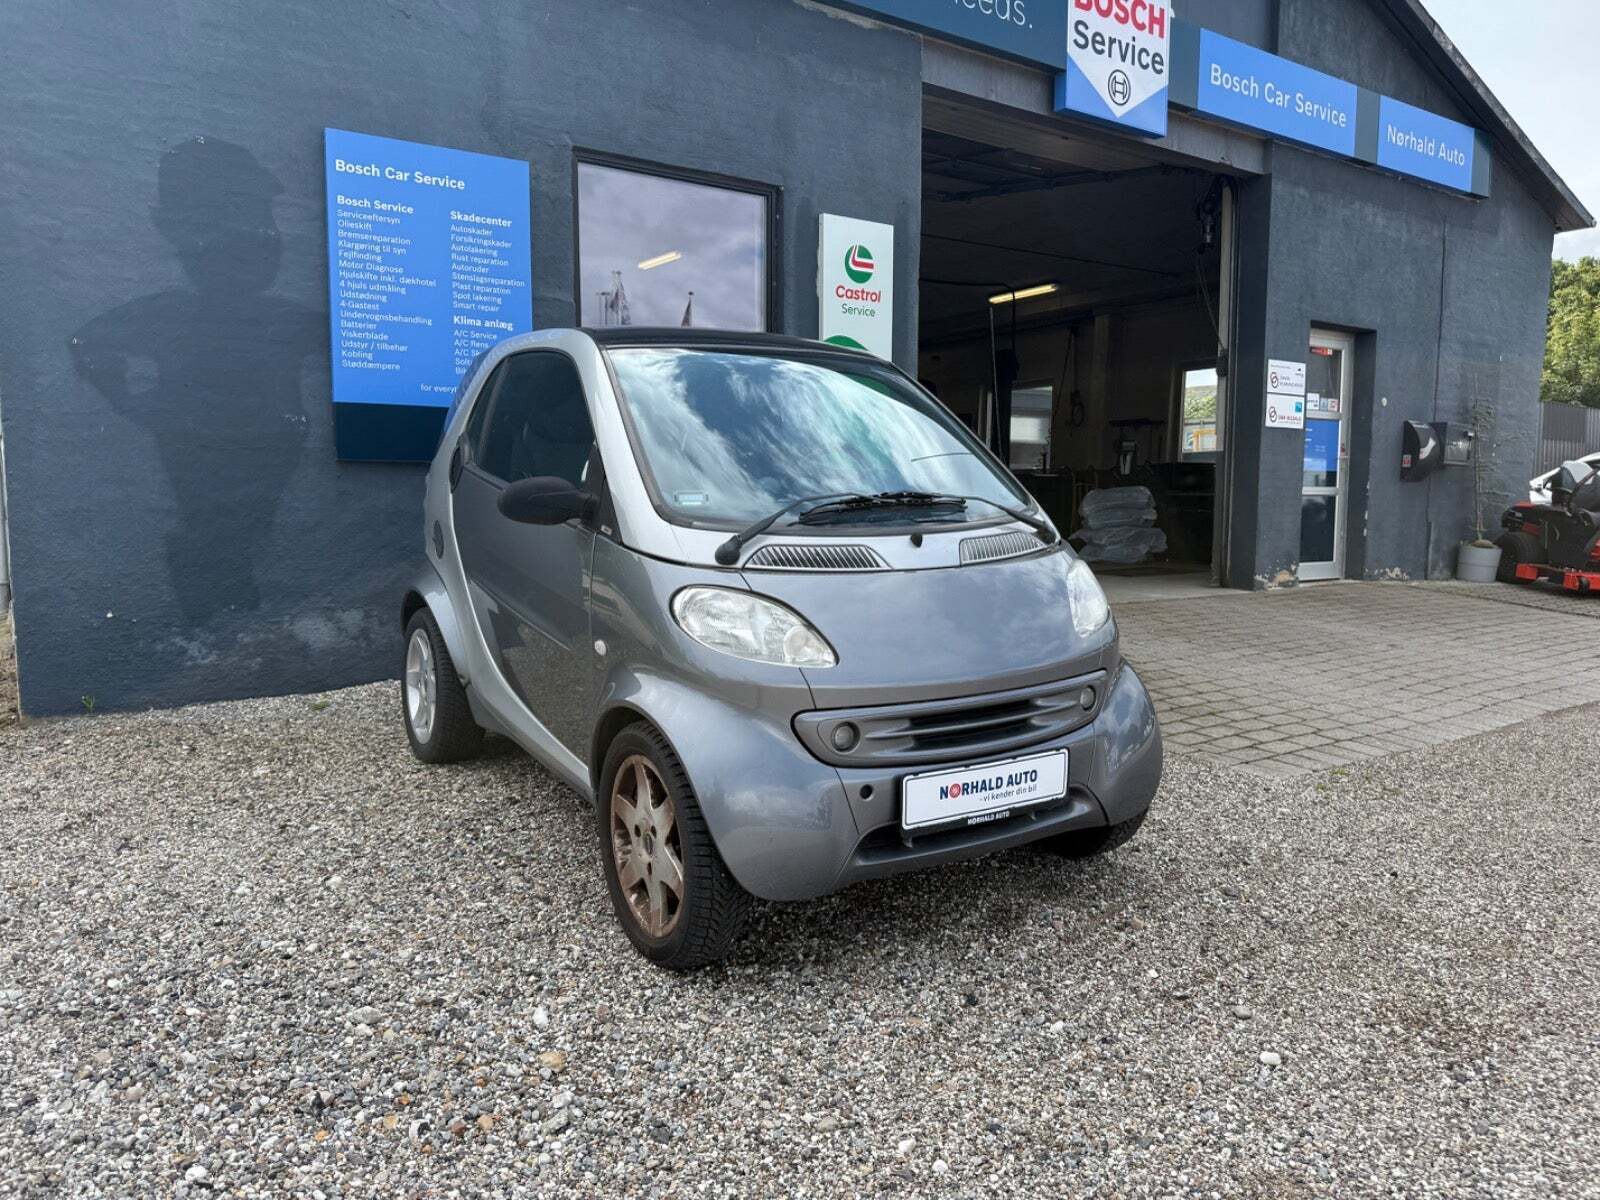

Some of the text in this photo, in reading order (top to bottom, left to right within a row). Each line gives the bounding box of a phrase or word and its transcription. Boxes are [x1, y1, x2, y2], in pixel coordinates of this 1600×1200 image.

[1073, 19, 1164, 75] Service
[1210, 63, 1346, 127] Bosch Car Service
[1387, 123, 1465, 166] Nørhald Auto
[335, 159, 465, 189] Bosch Car Service
[337, 195, 414, 214] Bosch Service
[337, 209, 400, 224] Serviceeftersyn
[450, 210, 512, 227] Skadecenter
[337, 219, 372, 230] Olieskift
[450, 224, 492, 236] Autoskader
[338, 229, 411, 245] Bremsereparation
[338, 240, 406, 255] Klargøring til syn
[339, 250, 382, 263] Fejlfinding
[451, 253, 509, 266] Rust reparation
[339, 260, 404, 273] Motor Diagnose
[452, 263, 489, 274] Autoruder
[339, 270, 378, 280] Hjulskifte
[399, 276, 437, 287] dækhotel
[347, 281, 367, 290] hjuls
[452, 281, 511, 296] Plast reparation
[340, 290, 387, 302] Udstødning
[453, 291, 470, 301] Spot
[835, 284, 881, 303] Castrol
[453, 301, 475, 310] Smart
[841, 303, 876, 317] Service
[341, 310, 432, 326] Undervognsbehandling
[454, 315, 513, 331] Klima anlæg
[341, 330, 389, 341] Viskerblade
[454, 329, 497, 340] A/C Service
[341, 340, 368, 349] Udstyr
[454, 339, 469, 347] A/C
[342, 350, 373, 360] Kobling
[342, 359, 400, 370] Støddæmpere
[420, 383, 433, 391] for
[1006, 769, 1038, 787] AUTO
[991, 789, 1014, 801] kender
[1016, 787, 1027, 795] din
[1028, 784, 1037, 793] bil
